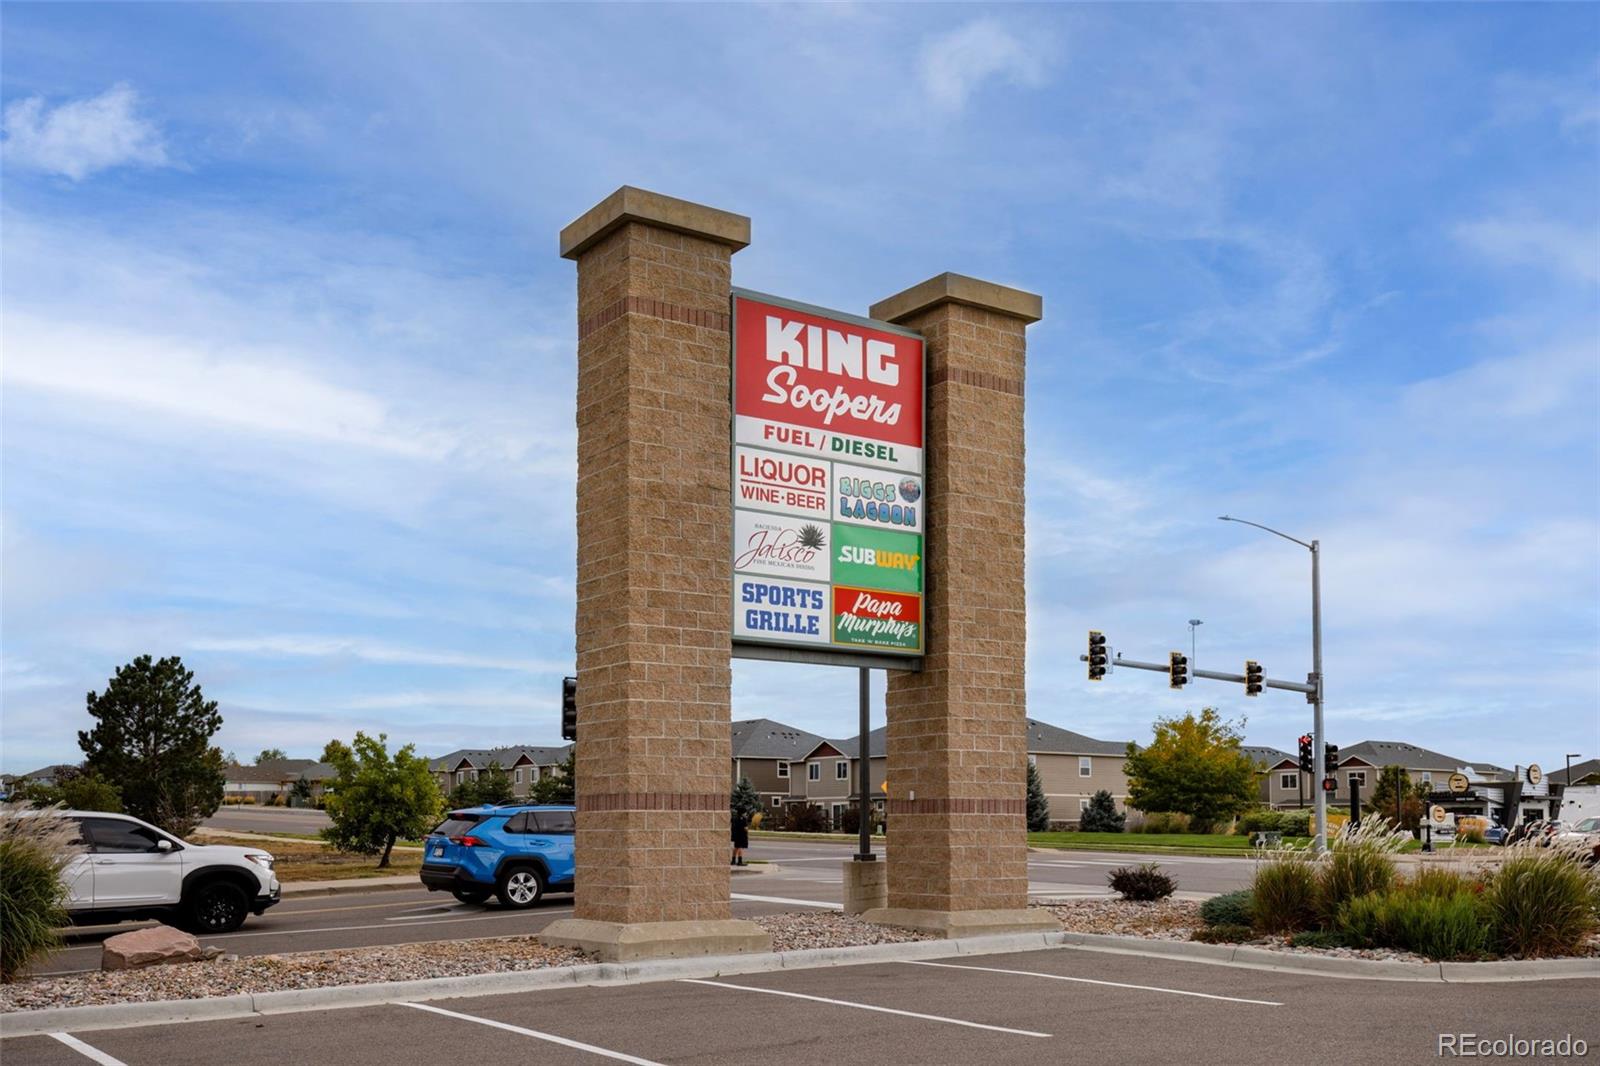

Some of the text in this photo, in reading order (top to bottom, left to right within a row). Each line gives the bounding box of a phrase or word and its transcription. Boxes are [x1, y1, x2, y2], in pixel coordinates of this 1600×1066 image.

[765, 315, 899, 387] KING
[762, 365, 902, 426] Soopers
[764, 425, 815, 448] FUEL
[831, 436, 898, 462] DIESEL
[740, 455, 826, 489] LIQUOR
[839, 476, 896, 503] BIGGS
[840, 496, 916, 527] LAGOON
[735, 528, 816, 569] Jalisco
[838, 545, 920, 571] SUBWAY
[742, 582, 823, 609] SPORTS
[852, 592, 903, 618] Papa
[746, 609, 820, 635] GRILLE
[837, 611, 916, 640] Murphy's
